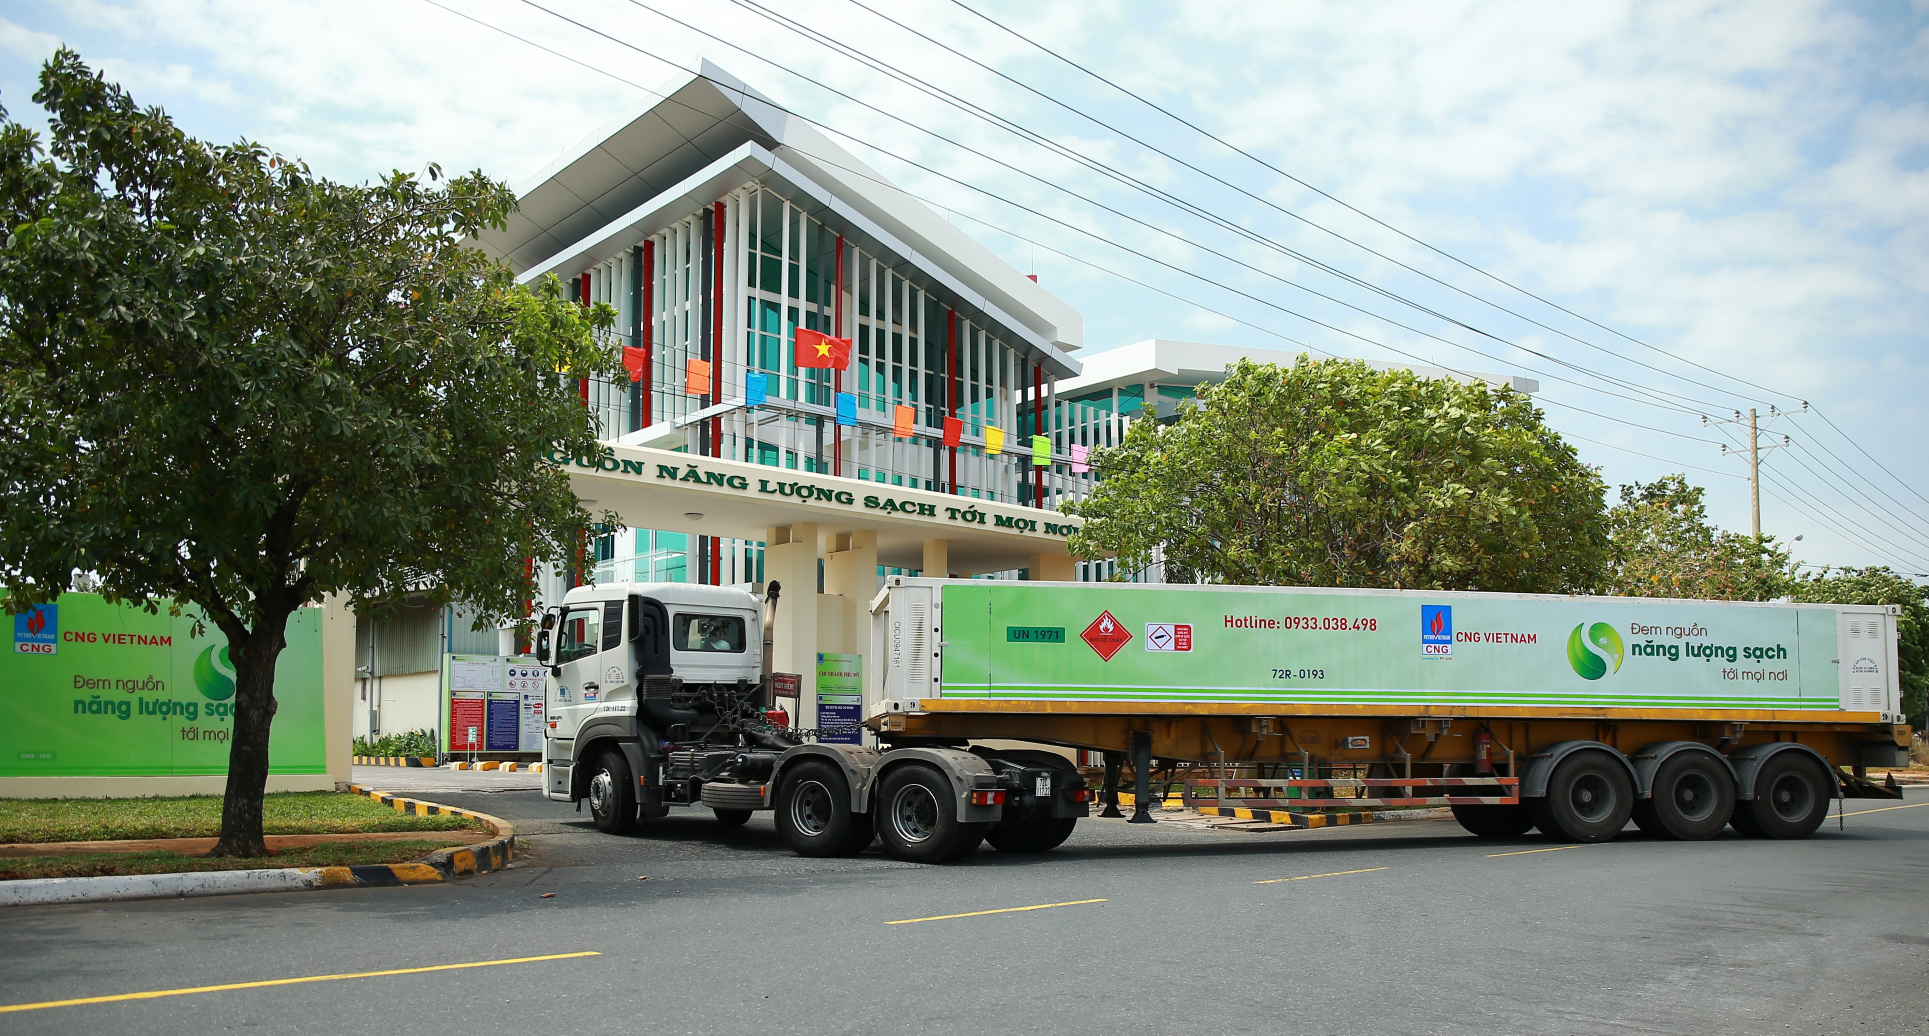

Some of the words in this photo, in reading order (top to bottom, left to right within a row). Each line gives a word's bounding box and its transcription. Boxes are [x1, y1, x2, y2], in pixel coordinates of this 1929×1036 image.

[541, 447, 645, 475] GUỒN
[656, 464, 750, 490] NĂNG
[759, 479, 855, 505] LƯỢNG
[864, 495, 937, 516] SẠCH
[945, 504, 987, 525] TỚI
[994, 514, 1038, 533] MỌI
[1223, 615, 1281, 630] Hotline:
[1284, 616, 1378, 631] 0933.038.498
[1631, 623, 1661, 636] Đem
[1666, 623, 1708, 639] nguồn
[17, 632, 55, 640] PETROVIETNAM
[63, 631, 97, 643] CNG
[101, 632, 172, 647] VIETNAM
[1013, 629, 1031, 641] UN
[1033, 629, 1060, 641] 1971
[1456, 631, 1481, 643] CNG
[1484, 632, 1537, 644] VIETNAM
[20, 643, 52, 653] CNG
[1425, 645, 1449, 654] CNG
[1631, 640, 1680, 661] năng
[1685, 642, 1737, 663] lượng
[1742, 644, 1788, 663] sạch
[1722, 667, 1738, 681] tới
[1741, 669, 1765, 683] mọi
[1768, 669, 1788, 682] nơi
[73, 675, 111, 690] Đem
[115, 674, 165, 694] nguồn
[73, 694, 131, 720] năng
[138, 697, 199, 722] lượng
[204, 701, 236, 721] sạc
[181, 726, 199, 741] tới
[203, 728, 229, 744] mọi
